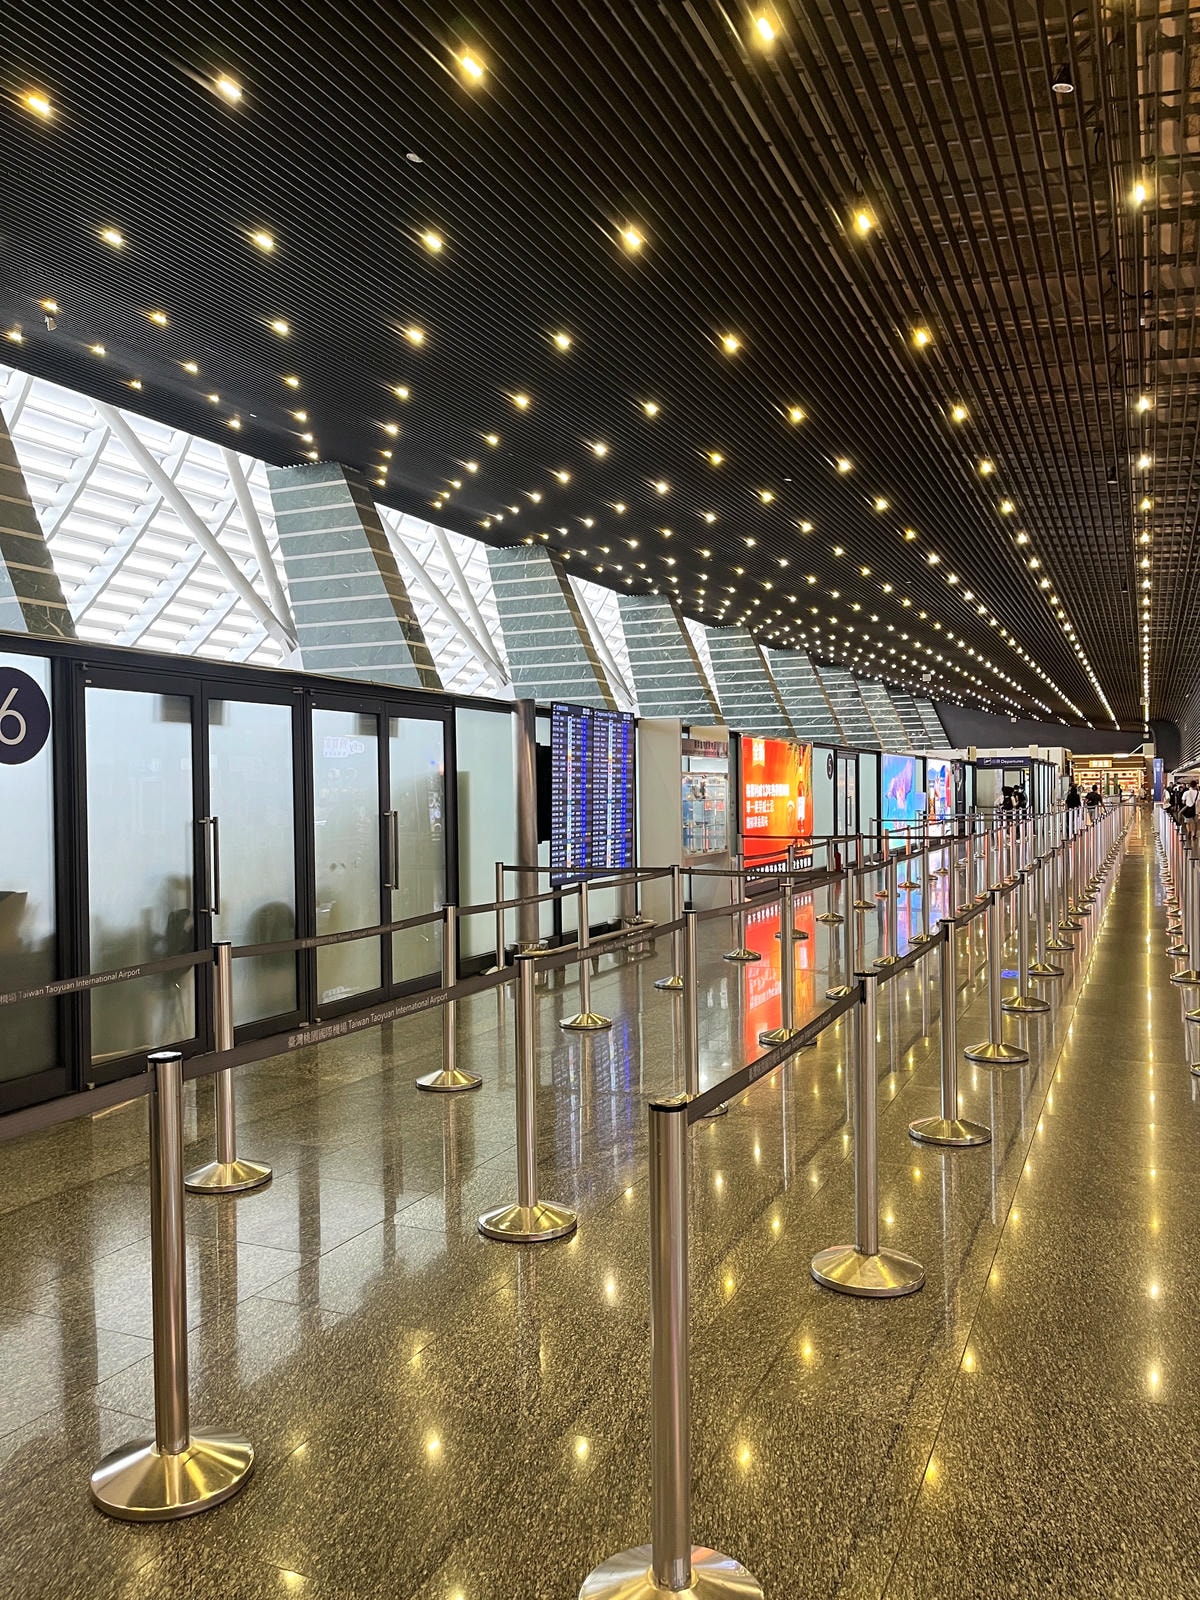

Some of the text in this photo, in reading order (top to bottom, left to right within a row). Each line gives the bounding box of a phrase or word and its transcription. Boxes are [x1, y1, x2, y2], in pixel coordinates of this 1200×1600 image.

[0, 687, 27, 746] 6
[19, 968, 140, 1000] Taiwan Taoyuan International Airport
[348, 992, 449, 1030] Taiwan Taoyuan International Airport
